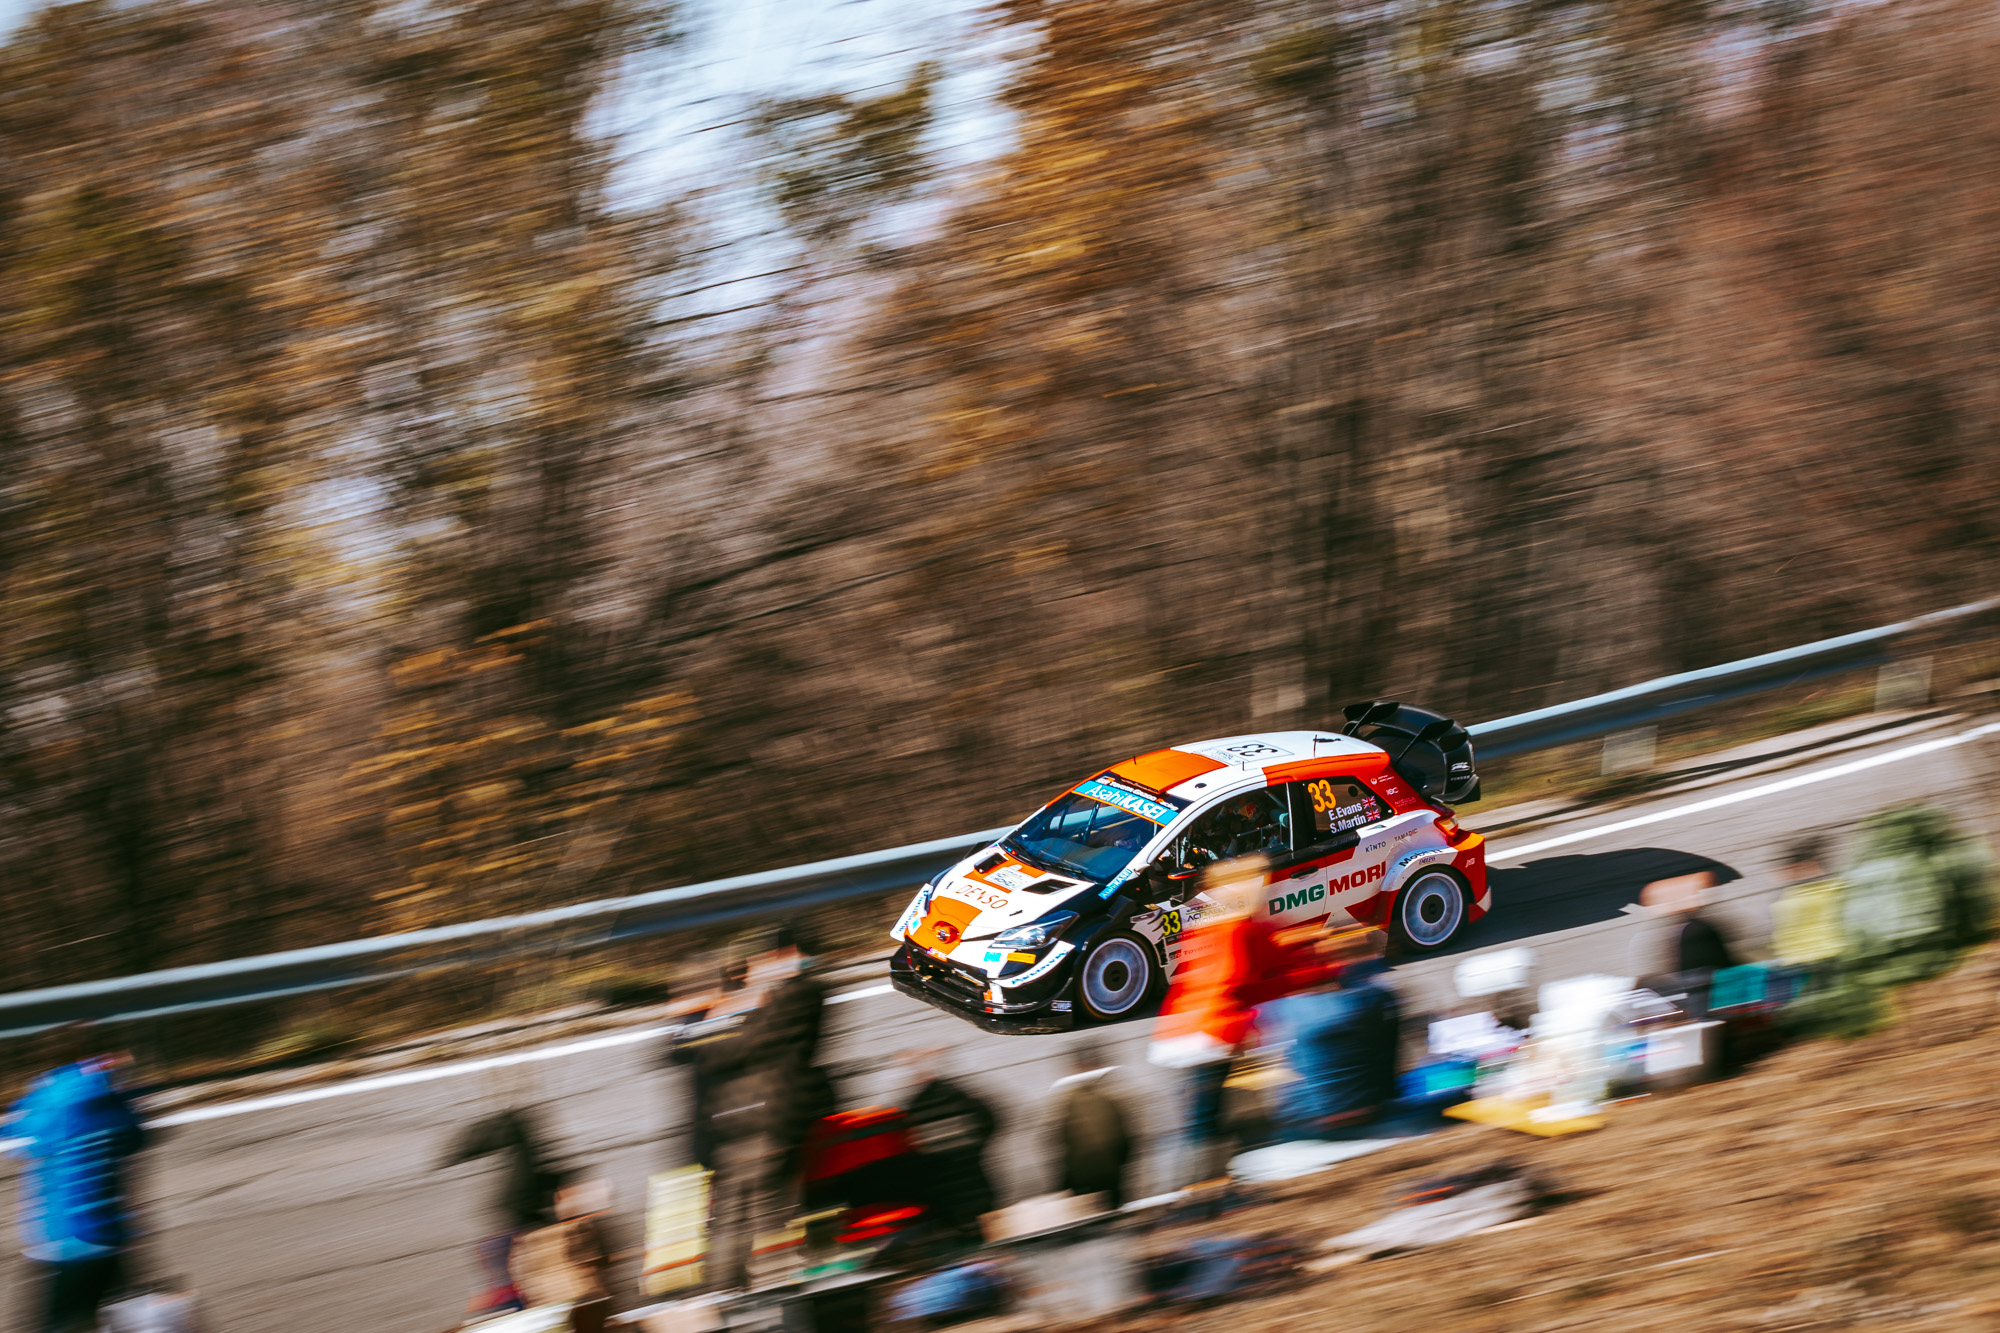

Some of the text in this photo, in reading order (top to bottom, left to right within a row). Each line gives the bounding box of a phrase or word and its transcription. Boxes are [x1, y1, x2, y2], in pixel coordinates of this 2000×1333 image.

[1085, 784, 1168, 820] AsahiKASEI
[1307, 779, 1336, 812] 33
[1328, 802, 1362, 820] E.Evans
[1329, 814, 1366, 834] S.Martin
[955, 884, 1008, 909] DENSO
[1269, 884, 1325, 916] DMG
[1329, 860, 1387, 895] MORI
[1161, 911, 1181, 936] 33
